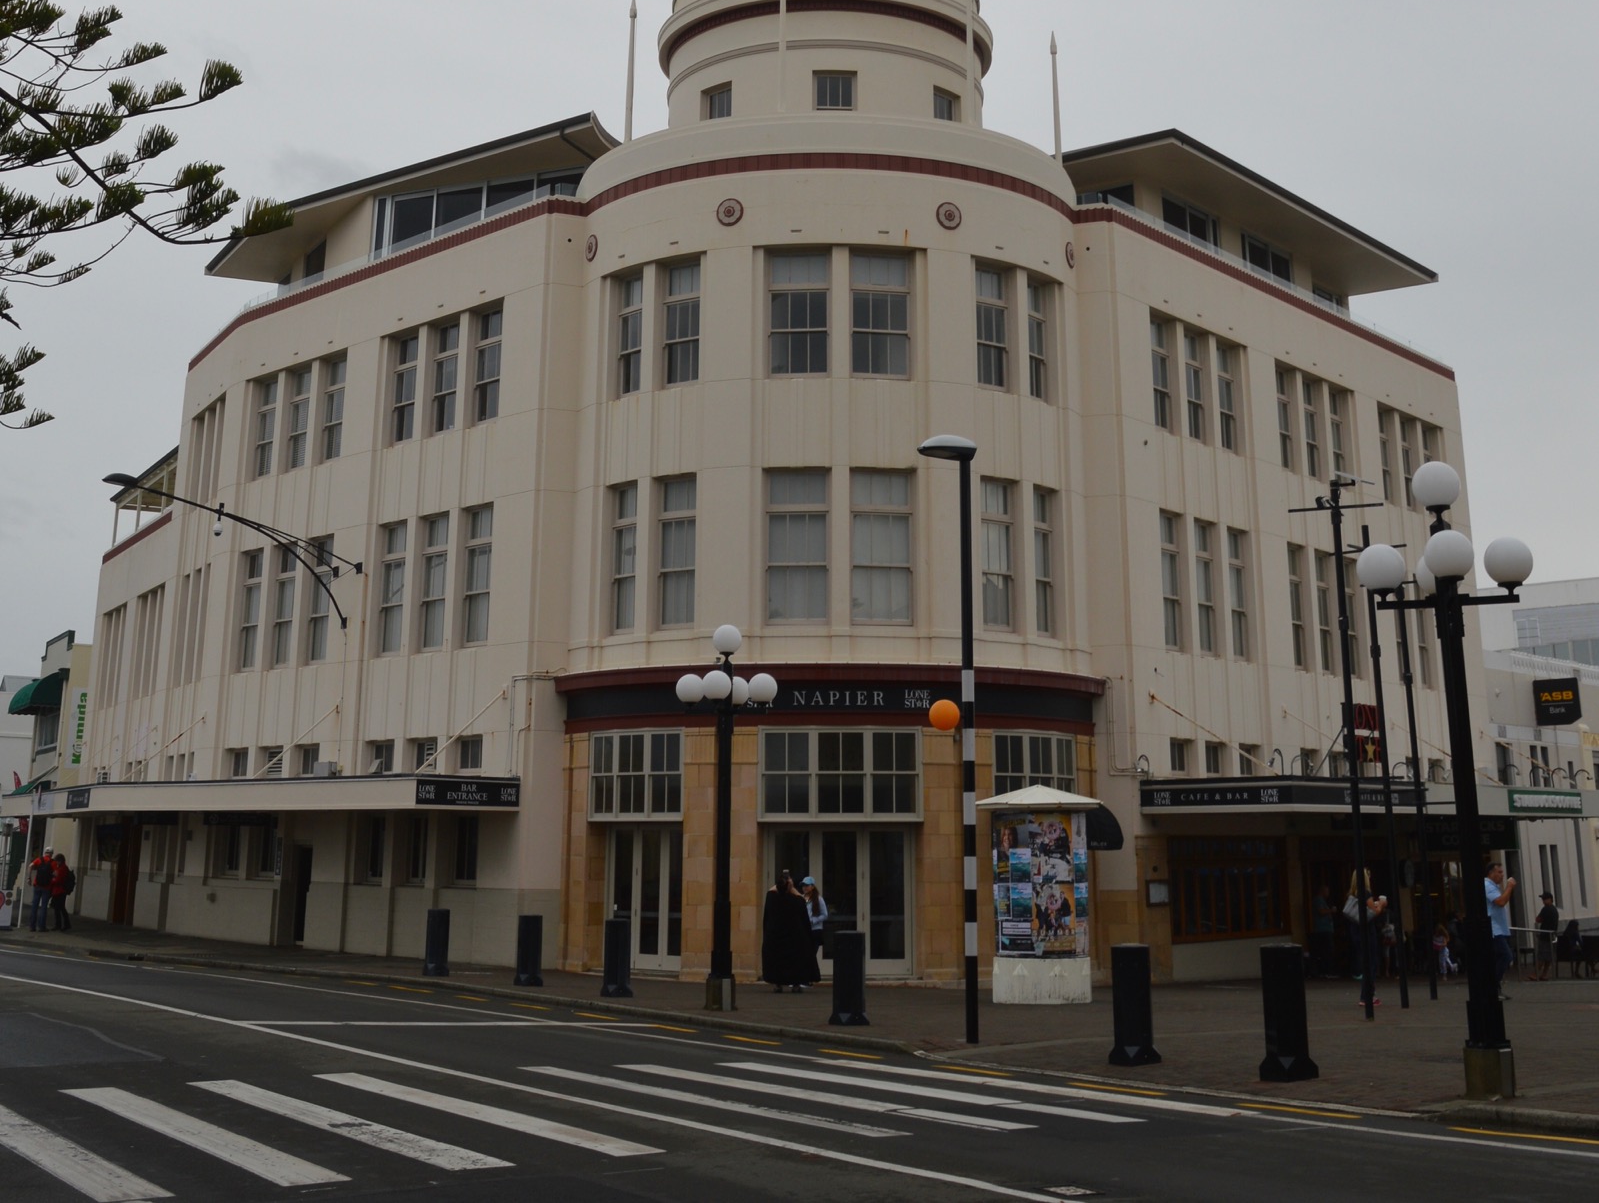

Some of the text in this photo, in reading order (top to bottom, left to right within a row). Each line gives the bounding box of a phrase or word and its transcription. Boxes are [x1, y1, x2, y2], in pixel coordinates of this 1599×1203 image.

[793, 690, 885, 706] NAPIER
[905, 689, 931, 699] LONE
[1549, 706, 1566, 714] Bank
[461, 784, 477, 792] BAR
[447, 792, 488, 801] ENTRANCE
[1180, 793, 1210, 801] CAFE
[1227, 792, 1249, 800] BAR
